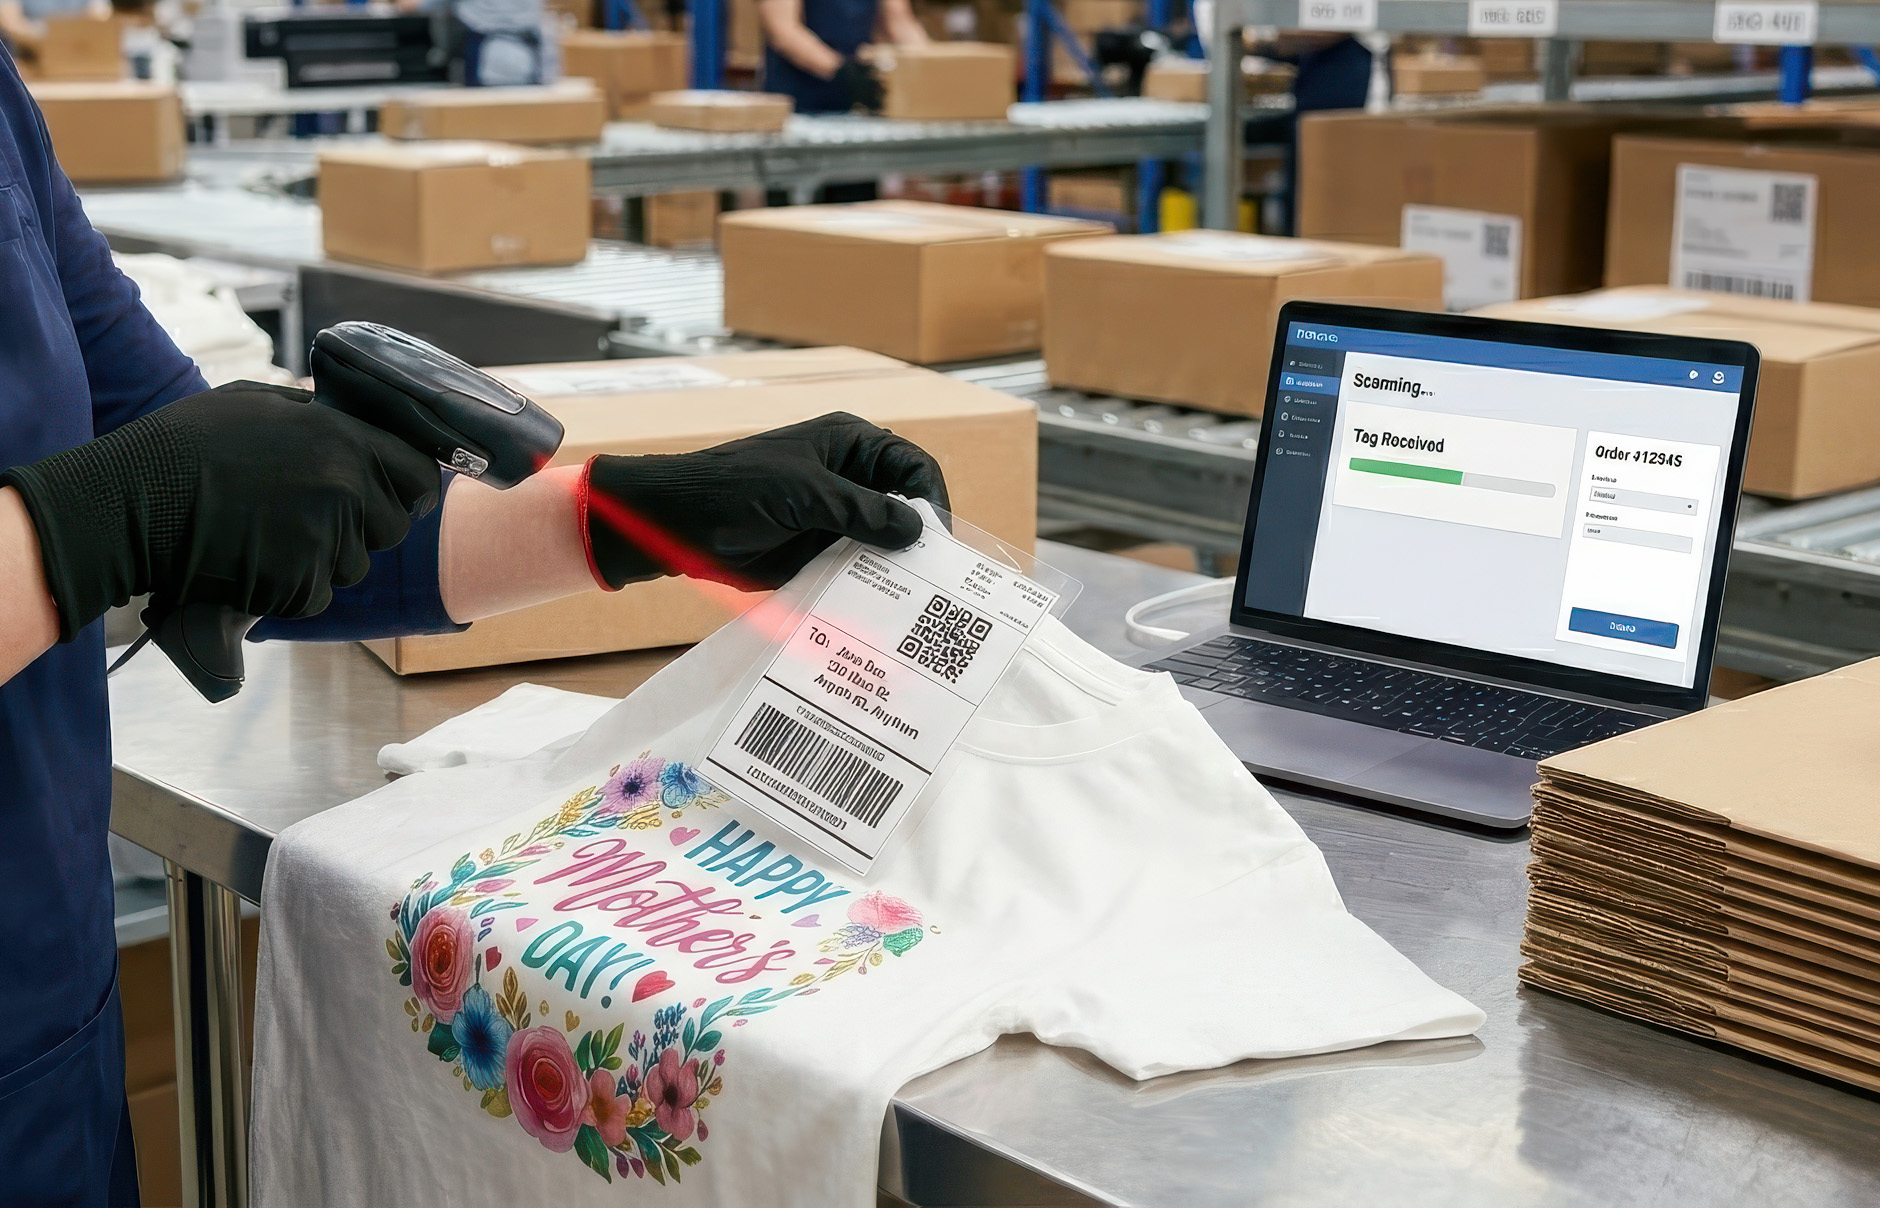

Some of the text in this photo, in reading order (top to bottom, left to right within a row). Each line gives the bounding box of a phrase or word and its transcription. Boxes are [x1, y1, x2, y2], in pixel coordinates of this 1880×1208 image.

[1353, 428, 1379, 448] Tag
[533, 838, 797, 985] Mother's
[683, 819, 852, 915] HAPPY
[520, 920, 656, 1010] DAY!
